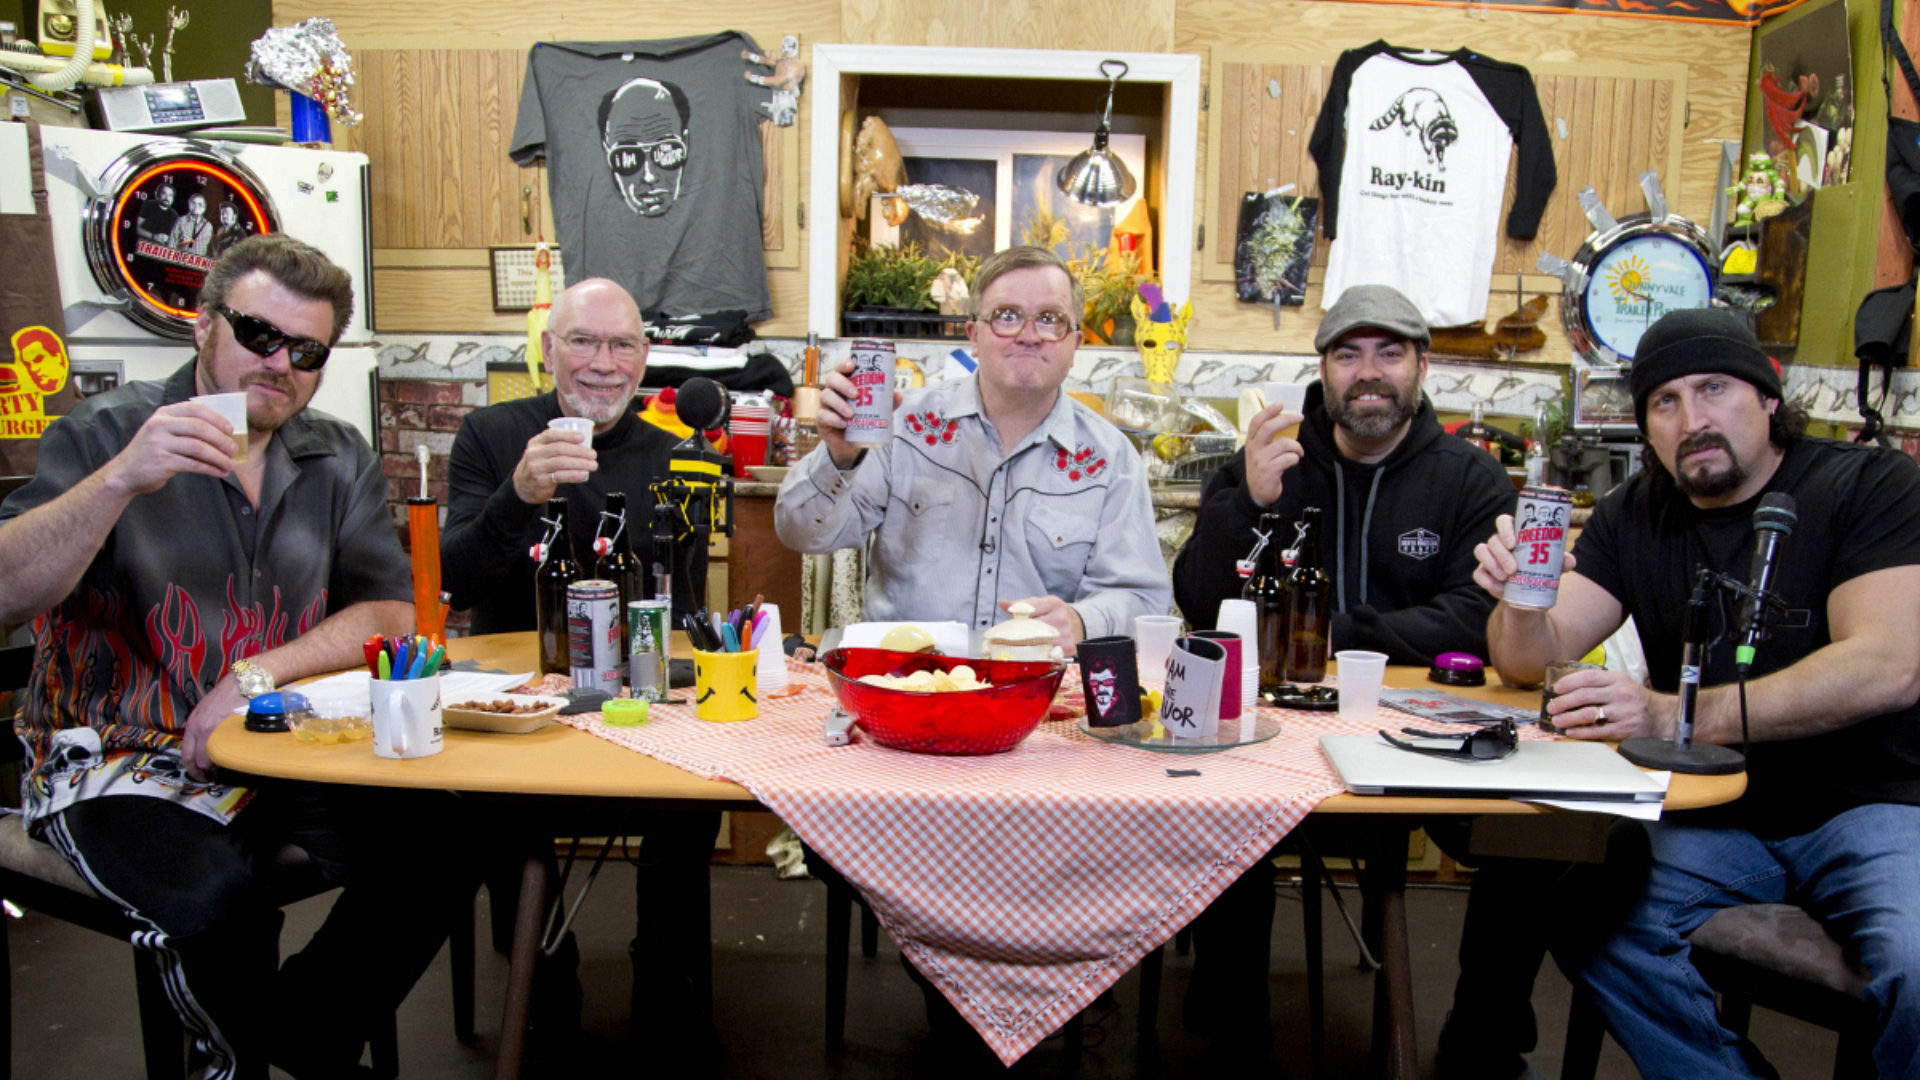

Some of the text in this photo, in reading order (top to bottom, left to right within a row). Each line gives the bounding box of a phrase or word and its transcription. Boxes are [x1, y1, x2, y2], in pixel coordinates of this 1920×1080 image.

[163, 174, 174, 184] 11
[196, 175, 207, 185] 12
[1370, 166, 1446, 193] Ray-kin
[135, 191, 148, 200] 10
[139, 241, 180, 263] TRAILER
[181, 252, 209, 270] PARK
[1622, 272, 1685, 297] SUNNYVALE
[1516, 526, 1564, 545] FREEDOM
[1528, 542, 1551, 565] 35
[1167, 659, 1186, 681] AM
